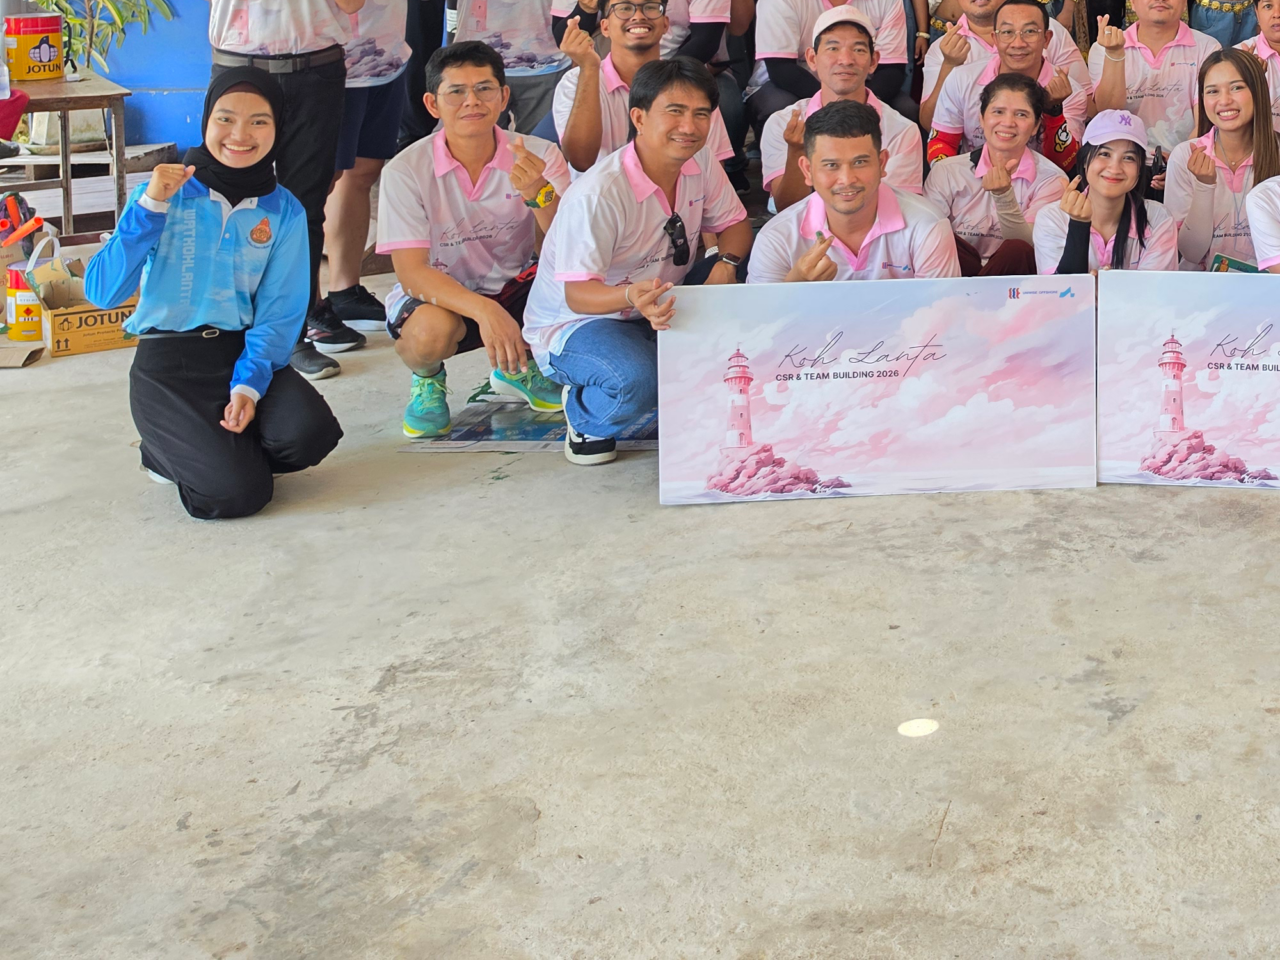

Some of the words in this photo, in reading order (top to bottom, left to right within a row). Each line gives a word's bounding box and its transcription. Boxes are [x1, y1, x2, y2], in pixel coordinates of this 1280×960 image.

[26, 62, 61, 75] JOTUN
[76, 310, 133, 329] JOTUN
[1210, 323, 1273, 358] Koh
[778, 331, 843, 368] Koh
[849, 333, 947, 377] Lanta
[1207, 362, 1225, 370] CSR
[1226, 362, 1232, 370] &
[1234, 362, 1259, 371] TEAM
[775, 373, 793, 381] CSR
[796, 372, 802, 380] &
[804, 371, 830, 380] TEAM
[833, 370, 874, 379] BUILDING
[876, 369, 899, 378] 2026
